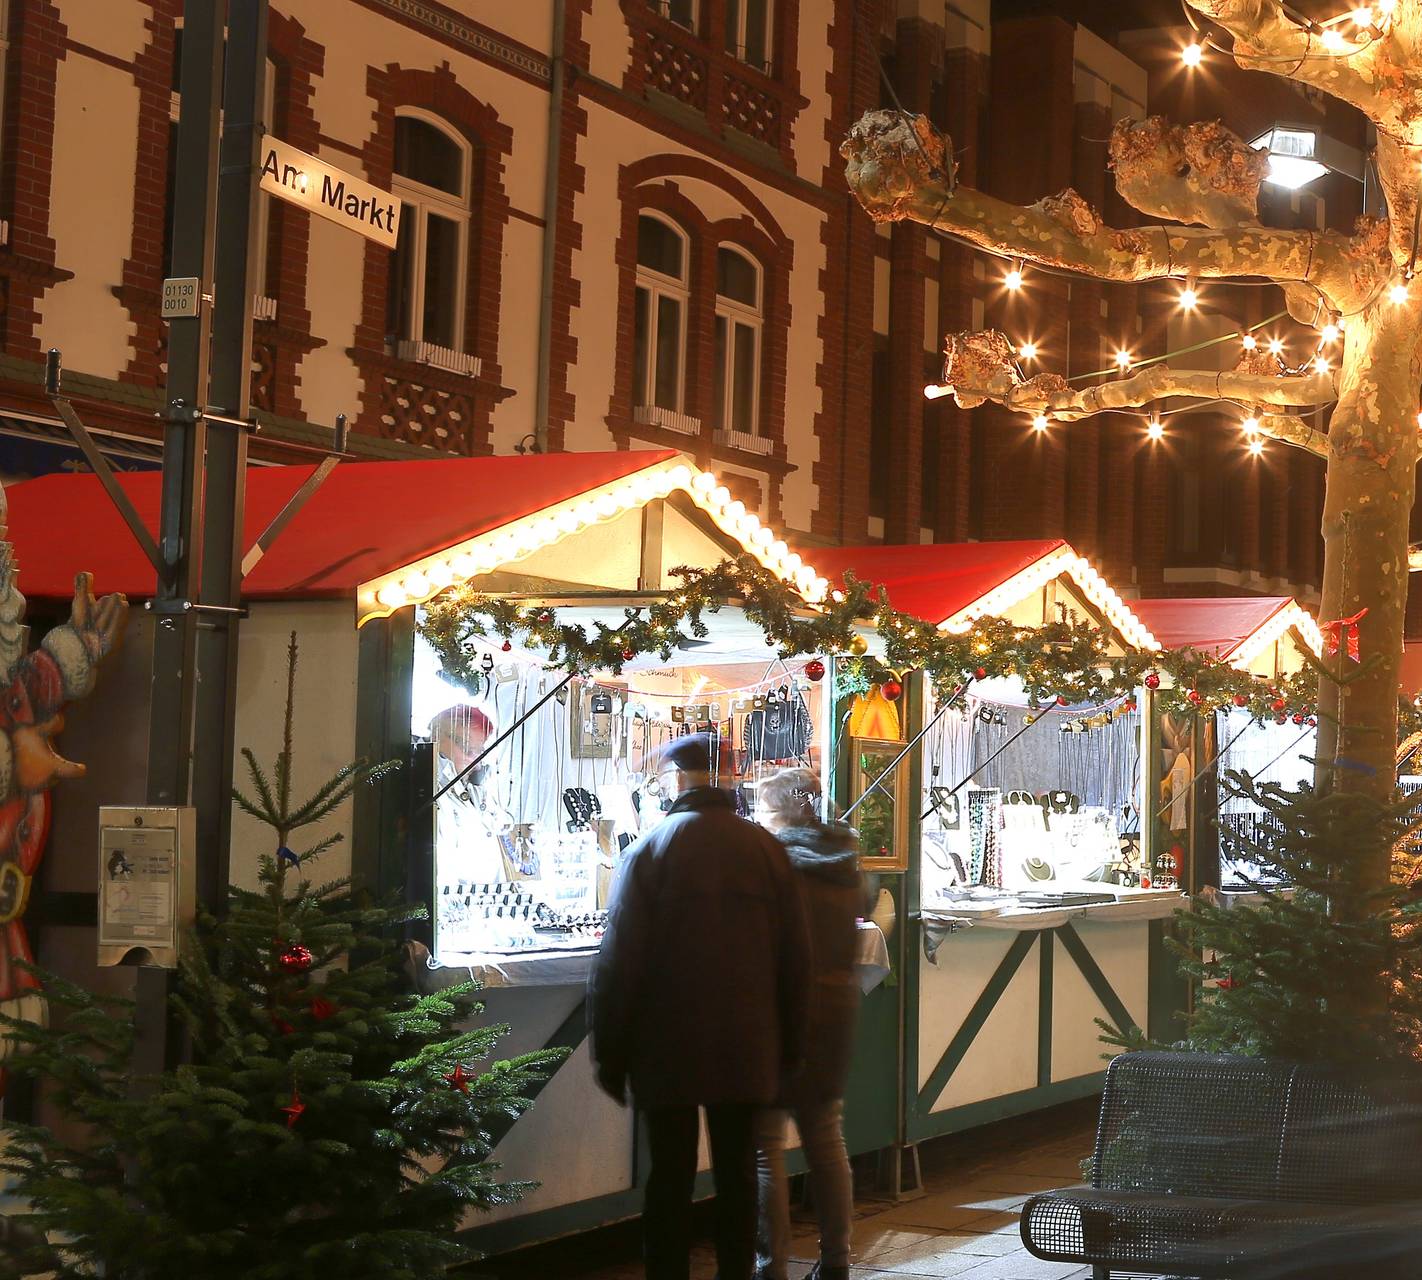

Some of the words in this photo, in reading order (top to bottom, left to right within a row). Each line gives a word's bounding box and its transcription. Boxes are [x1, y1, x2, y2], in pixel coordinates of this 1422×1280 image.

[262, 149, 307, 194] Am
[321, 174, 395, 234] Markt
[166, 285, 194, 296] 01130
[165, 299, 187, 310] 0010
